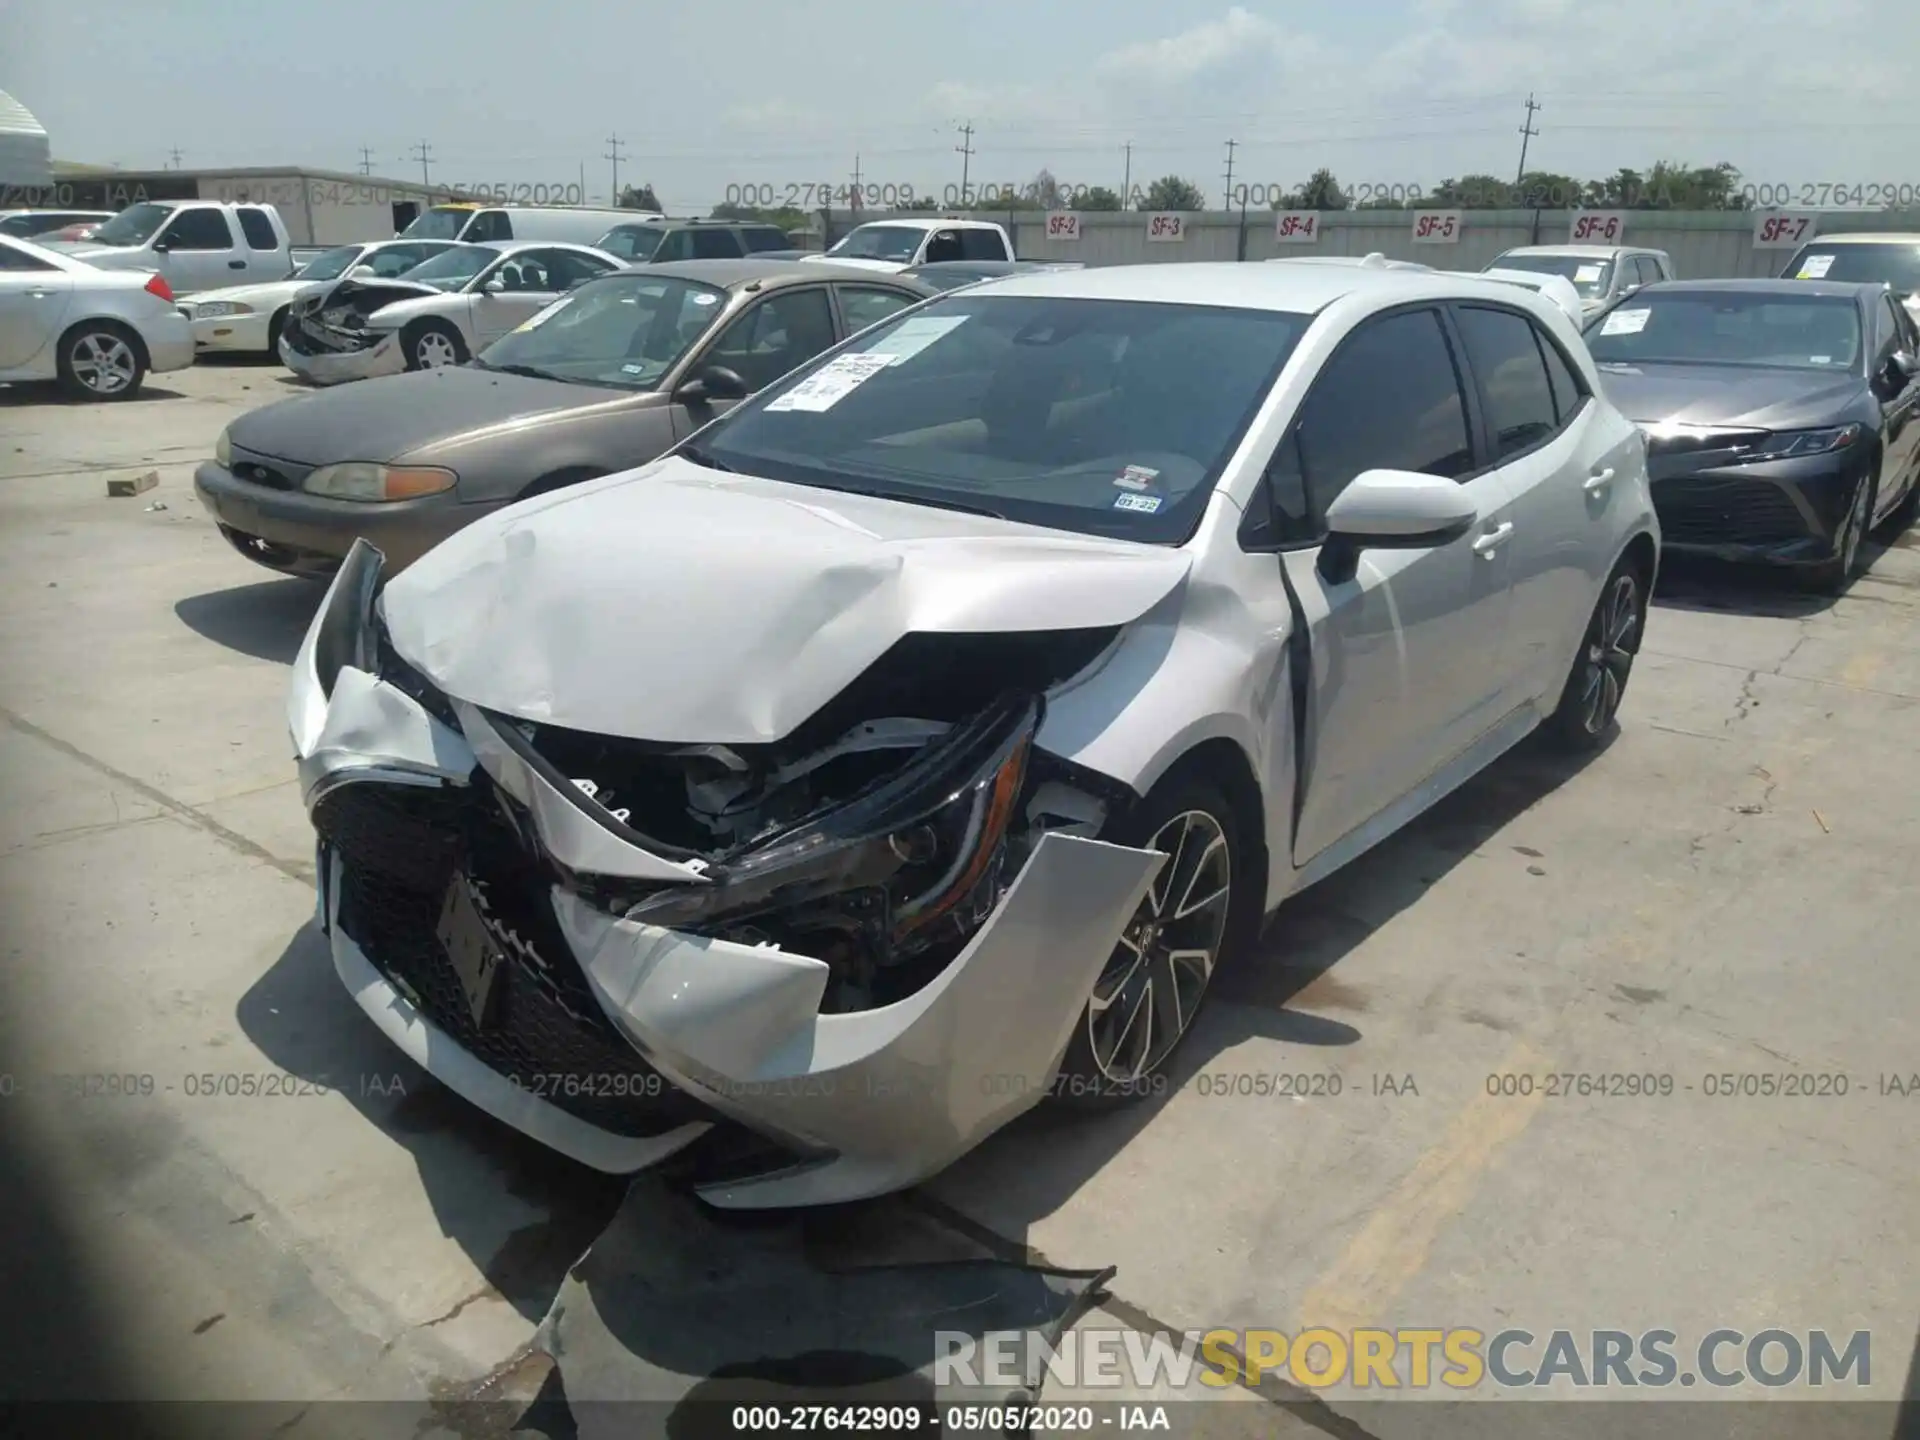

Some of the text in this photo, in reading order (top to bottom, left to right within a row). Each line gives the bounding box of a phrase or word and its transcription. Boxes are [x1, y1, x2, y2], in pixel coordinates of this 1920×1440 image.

[1050, 216, 1076, 235] SF-2
[1152, 217, 1180, 236] SF-3
[1280, 216, 1314, 236] SF-4
[1417, 216, 1454, 237] SF-5
[1574, 217, 1619, 238] SF-6
[1760, 217, 1809, 242] SF-7
